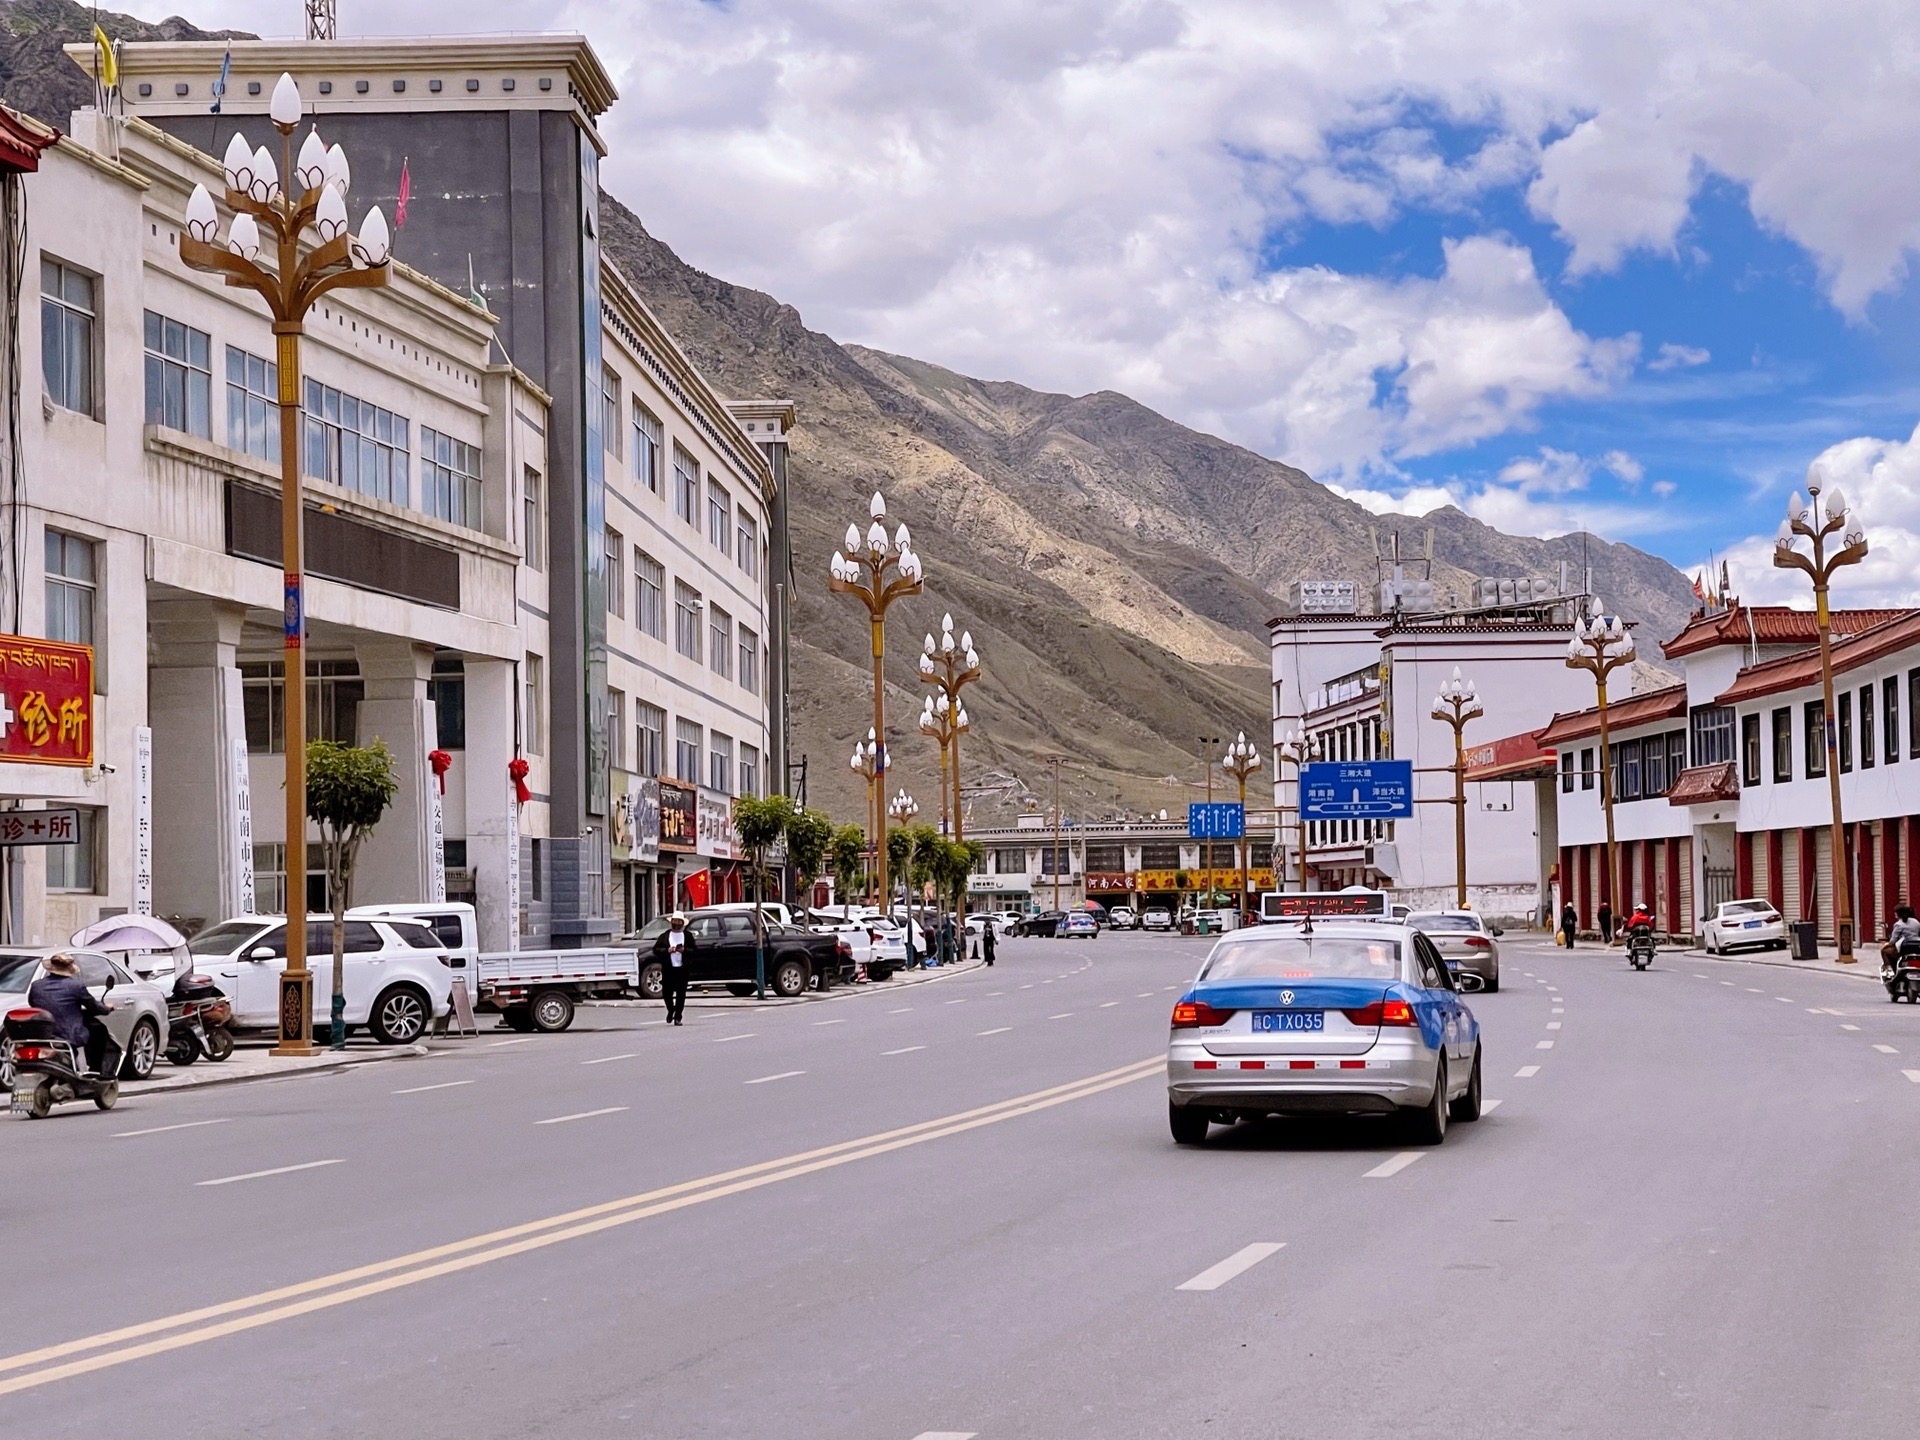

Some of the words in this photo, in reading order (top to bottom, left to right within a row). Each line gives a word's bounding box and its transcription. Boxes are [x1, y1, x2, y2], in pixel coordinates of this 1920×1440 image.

[19, 690, 87, 755] 诊所
[1340, 769, 1372, 777] 三湘大道
[1308, 789, 1335, 797] 湖南路
[1372, 787, 1405, 796] 泽当大道
[434, 805, 445, 903] 交通运输综合
[1088, 878, 1135, 889] 河南人家
